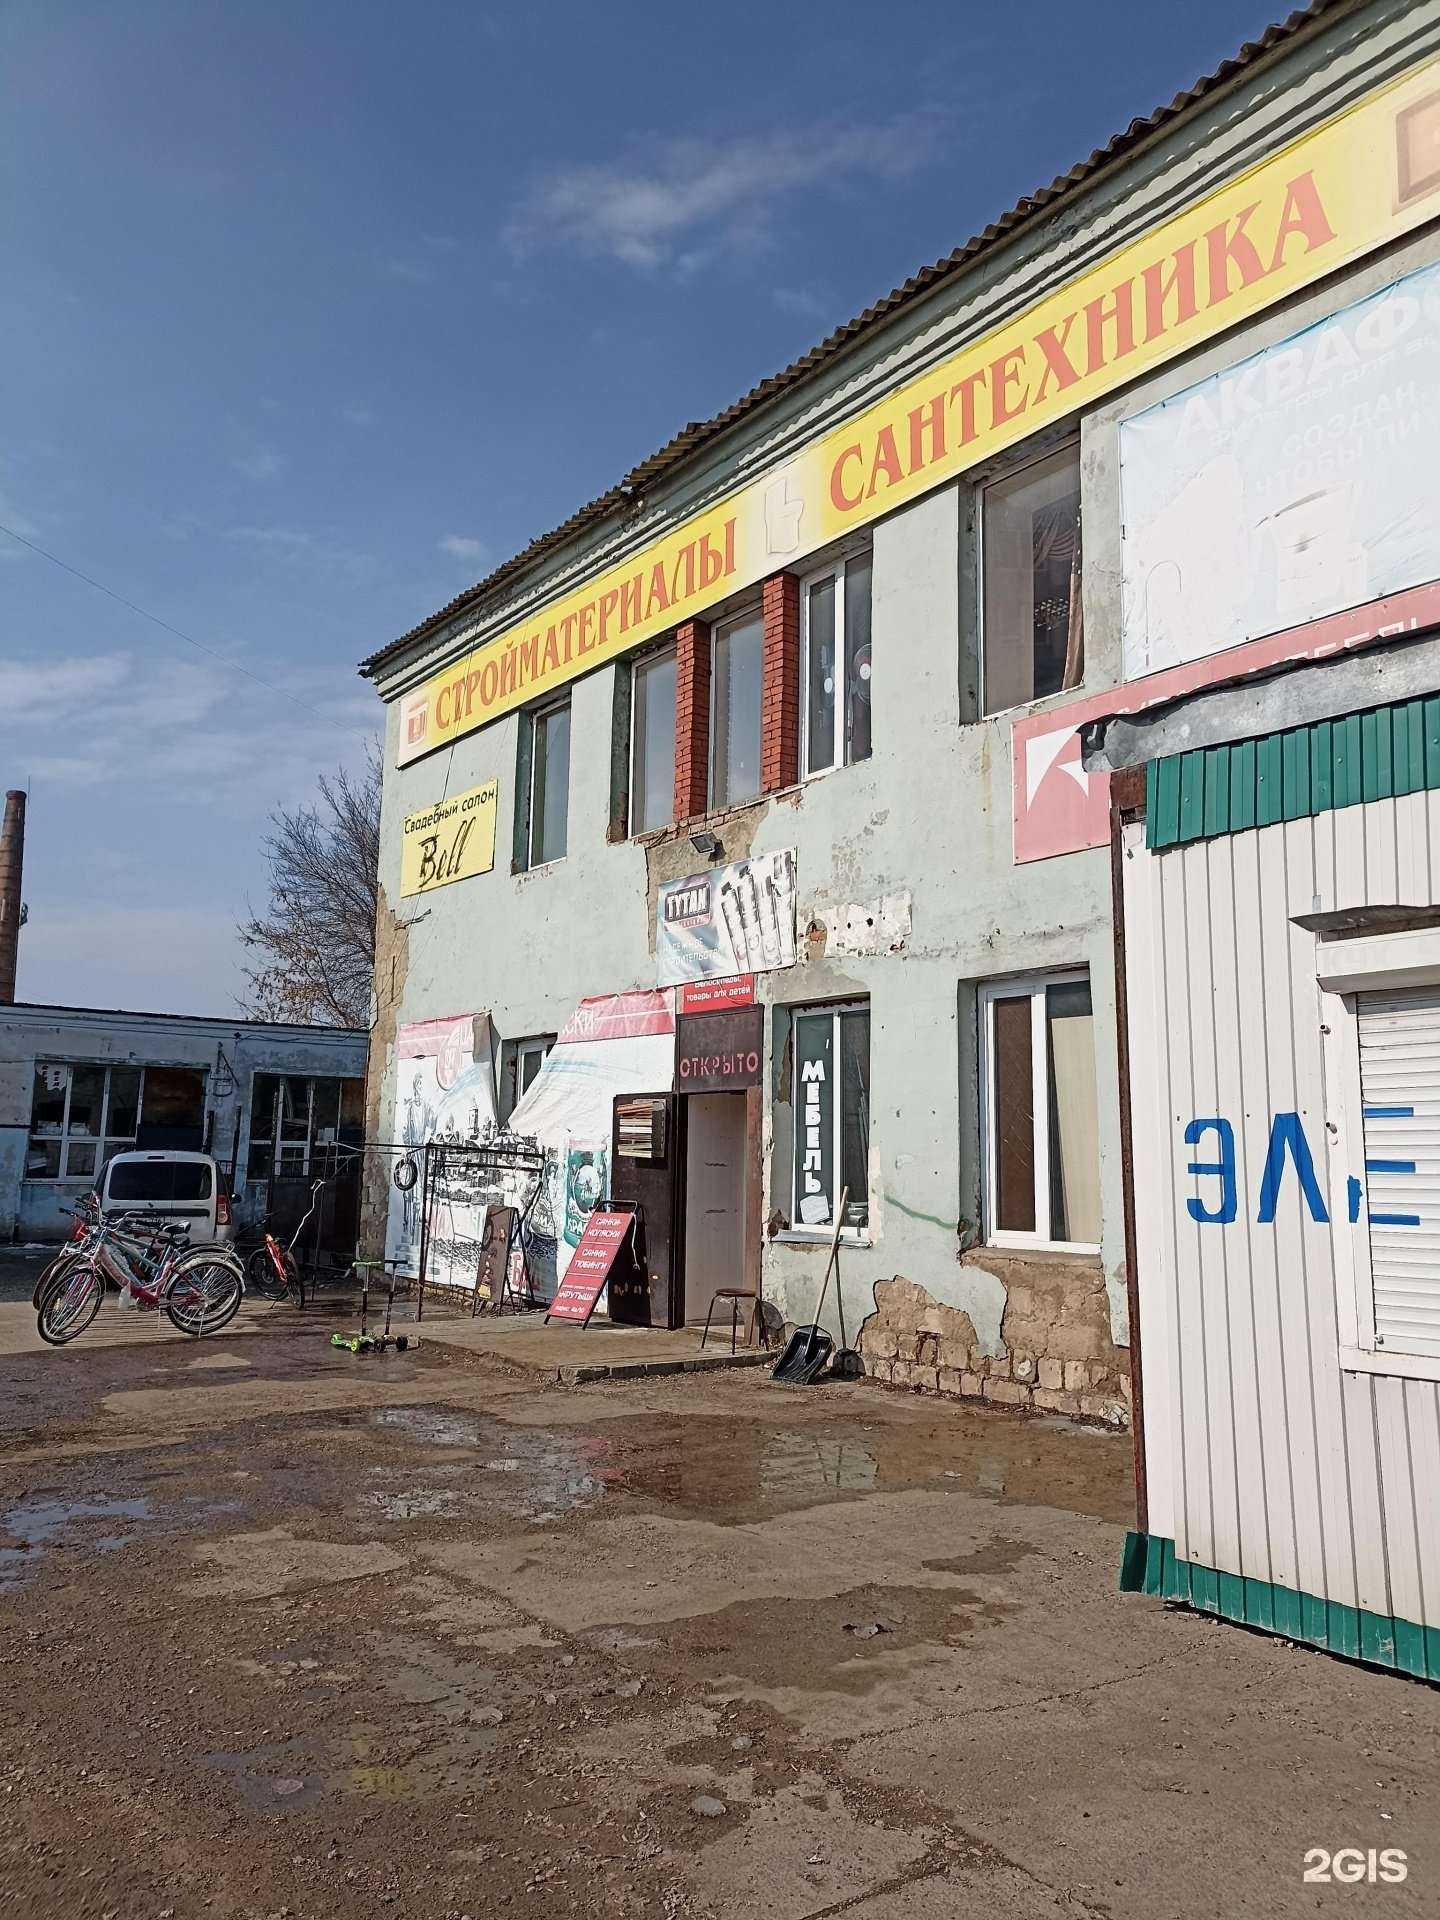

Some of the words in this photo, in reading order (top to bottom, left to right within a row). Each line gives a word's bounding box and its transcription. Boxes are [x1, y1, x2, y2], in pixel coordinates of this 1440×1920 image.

[829, 169, 1338, 512] САНТЕХНИКА
[435, 517, 737, 730] СТРОЙМАТЕРИАЛЫ
[404, 801, 458, 834] Свадебный
[461, 788, 495, 813] салон
[680, 1052, 759, 1078] ОТКРЫТО
[801, 1060, 825, 1194] МЕБЕЛЬ
